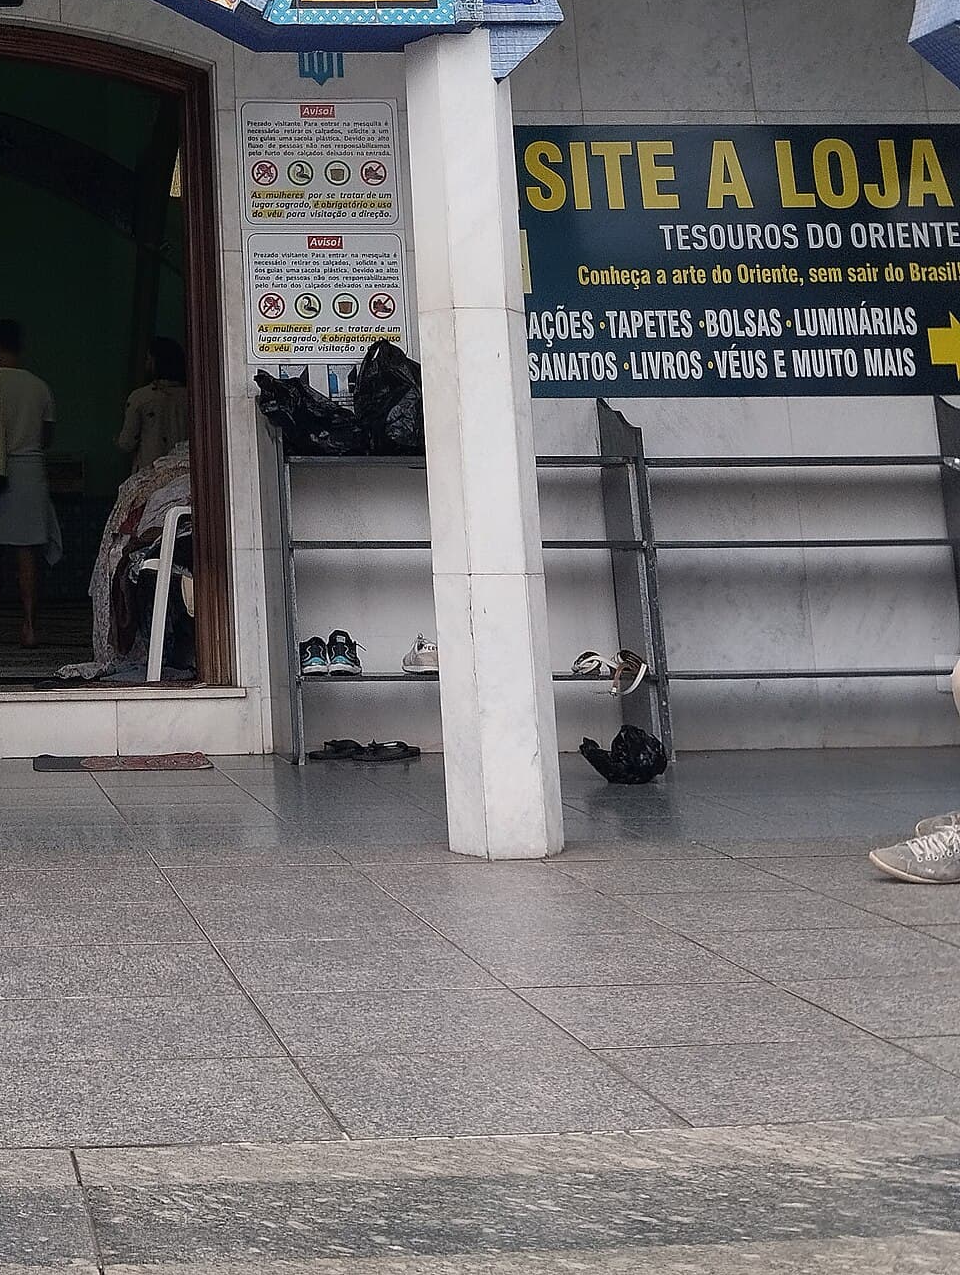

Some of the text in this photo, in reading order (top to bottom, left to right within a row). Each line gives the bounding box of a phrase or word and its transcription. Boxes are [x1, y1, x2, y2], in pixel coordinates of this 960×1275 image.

[302, 106, 334, 116] Aviso!
[707, 140, 754, 209] A
[775, 138, 953, 210] LOJA
[310, 237, 342, 247] Aviso!
[659, 222, 960, 251] TESOUROS DO ORIENTE
[577, 265, 651, 290] Conheça
[656, 269, 667, 284] a
[672, 265, 707, 284] arte
[712, 264, 732, 284] do
[737, 263, 804, 287] Oriente,
[808, 267, 843, 283] sem
[847, 263, 879, 283] sair
[884, 262, 905, 282] do
[526, 301, 918, 348] AÇÕES TAPETES BOLSAS LUMINÁRIAS
[630, 350, 703, 380] LIVROS
[713, 344, 768, 379] VÉUS
[773, 349, 787, 378] E
[792, 348, 858, 378] MUITO
[863, 347, 916, 377] MAIS
